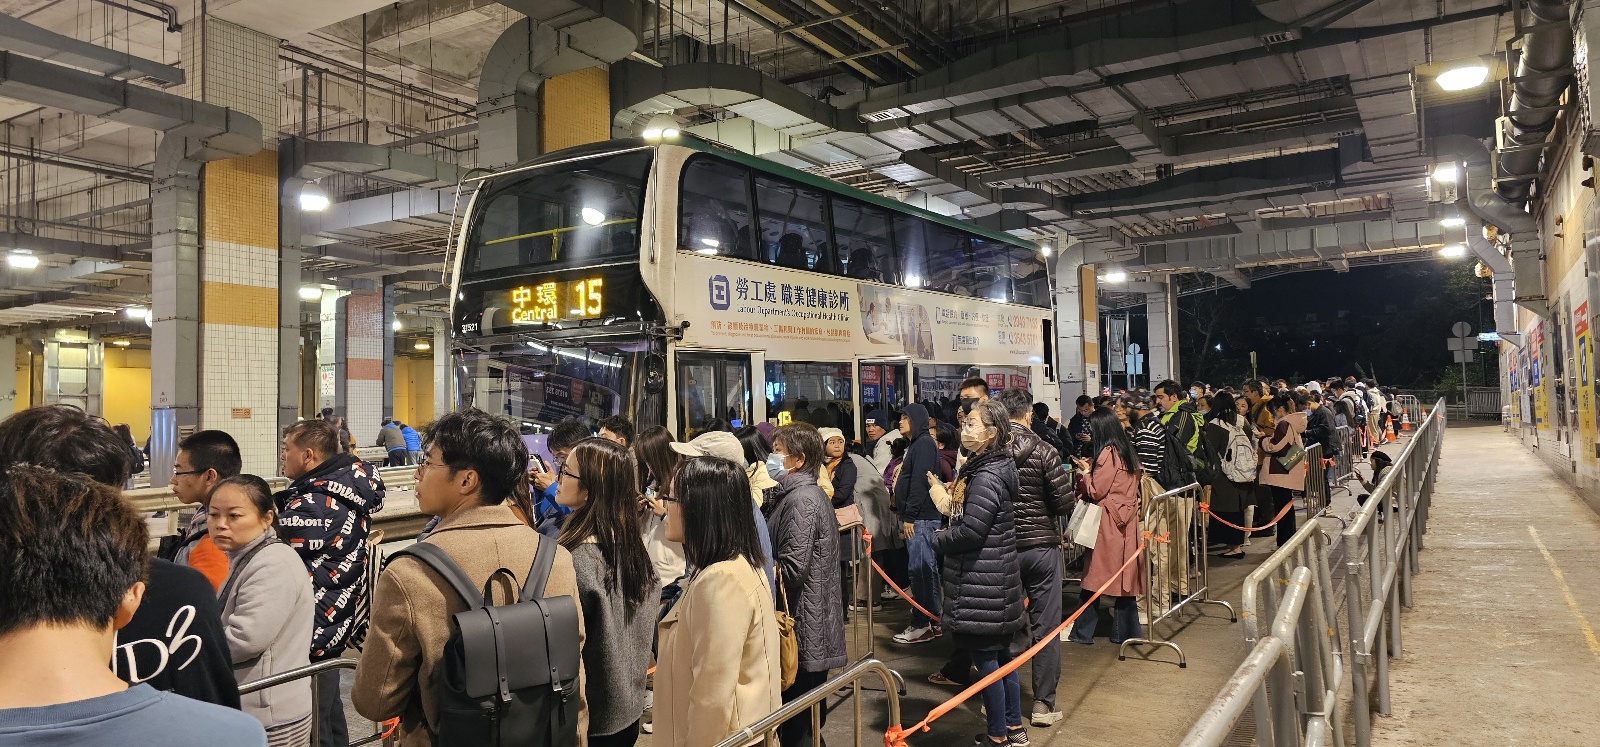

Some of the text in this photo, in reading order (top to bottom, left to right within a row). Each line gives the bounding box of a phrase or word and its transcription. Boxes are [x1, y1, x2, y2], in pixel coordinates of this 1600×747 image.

[512, 282, 557, 308] 中環
[575, 278, 602, 316] 15
[735, 277, 850, 312] 勞工處 職業健康診所
[512, 304, 558, 321] Central
[327, 480, 367, 506] Wilson
